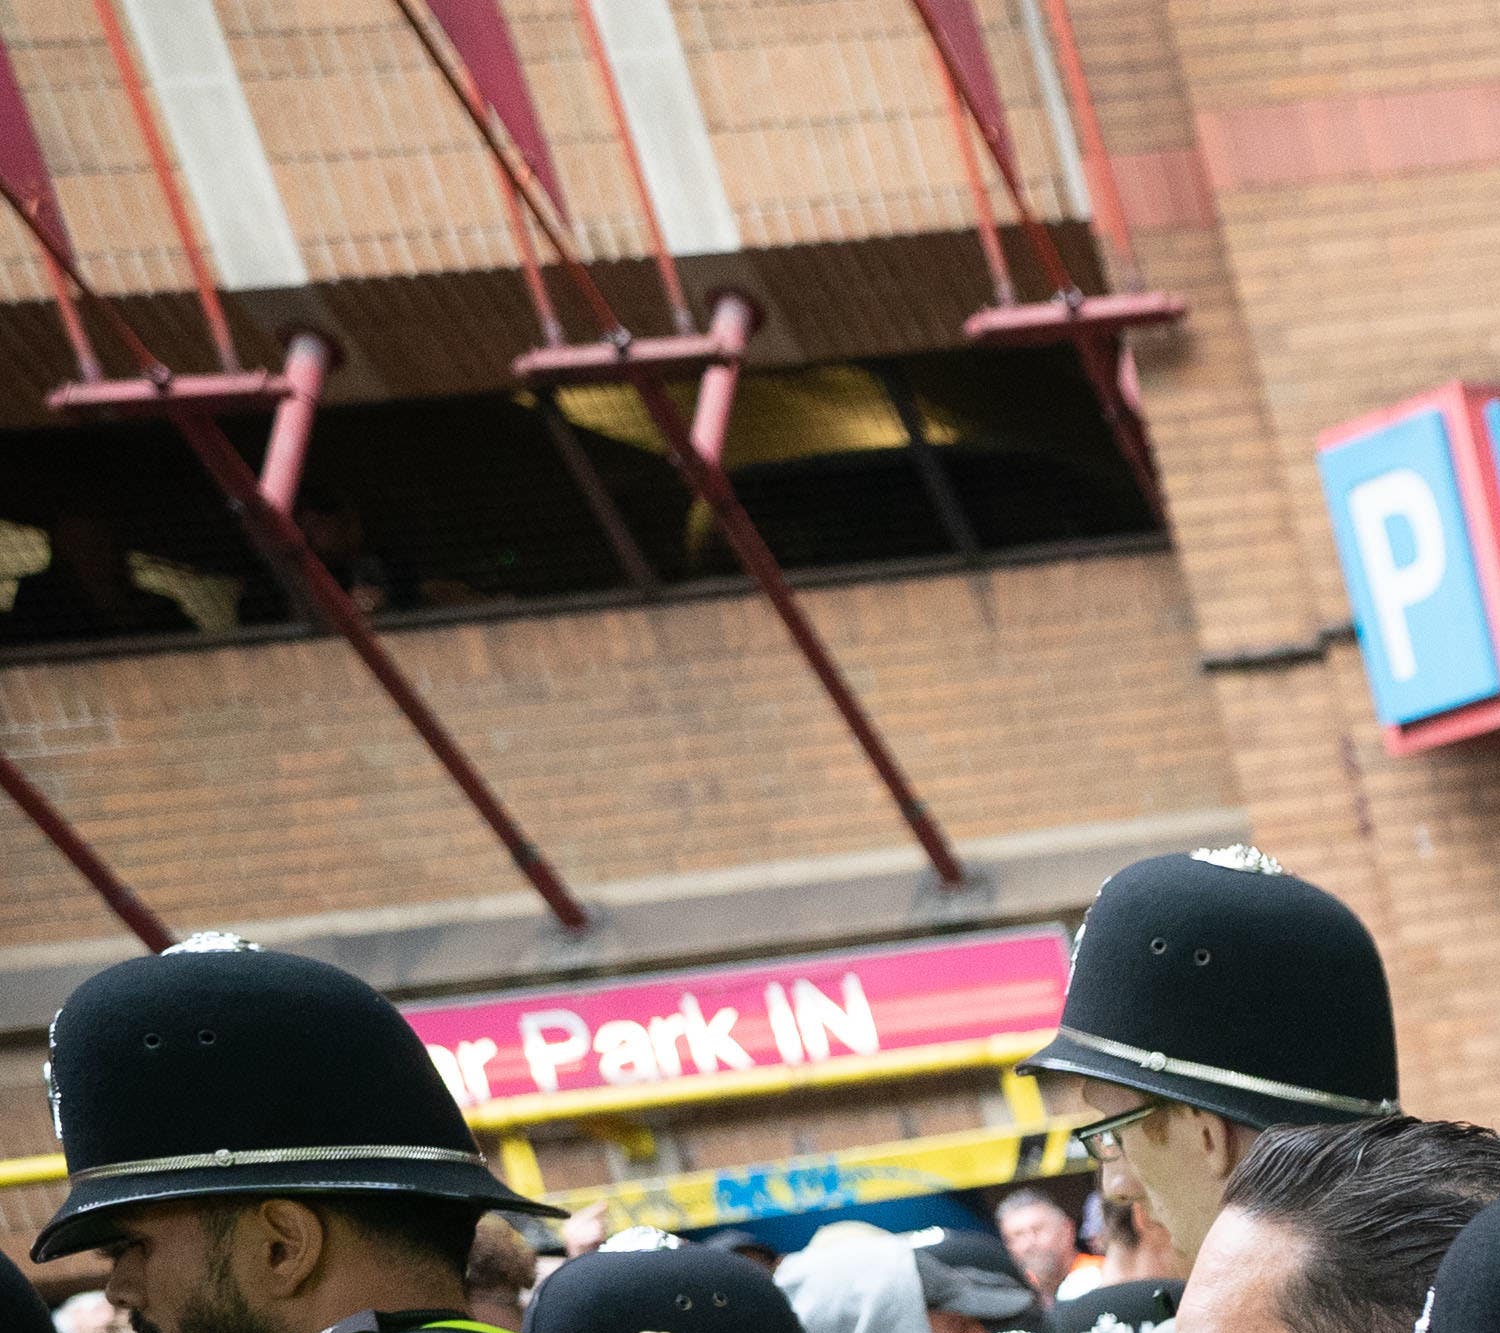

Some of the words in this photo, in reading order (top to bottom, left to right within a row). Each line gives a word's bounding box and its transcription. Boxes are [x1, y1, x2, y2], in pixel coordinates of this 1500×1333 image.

[1348, 467, 1448, 682] P
[519, 992, 756, 1094] Park
[765, 971, 880, 1066] IN
